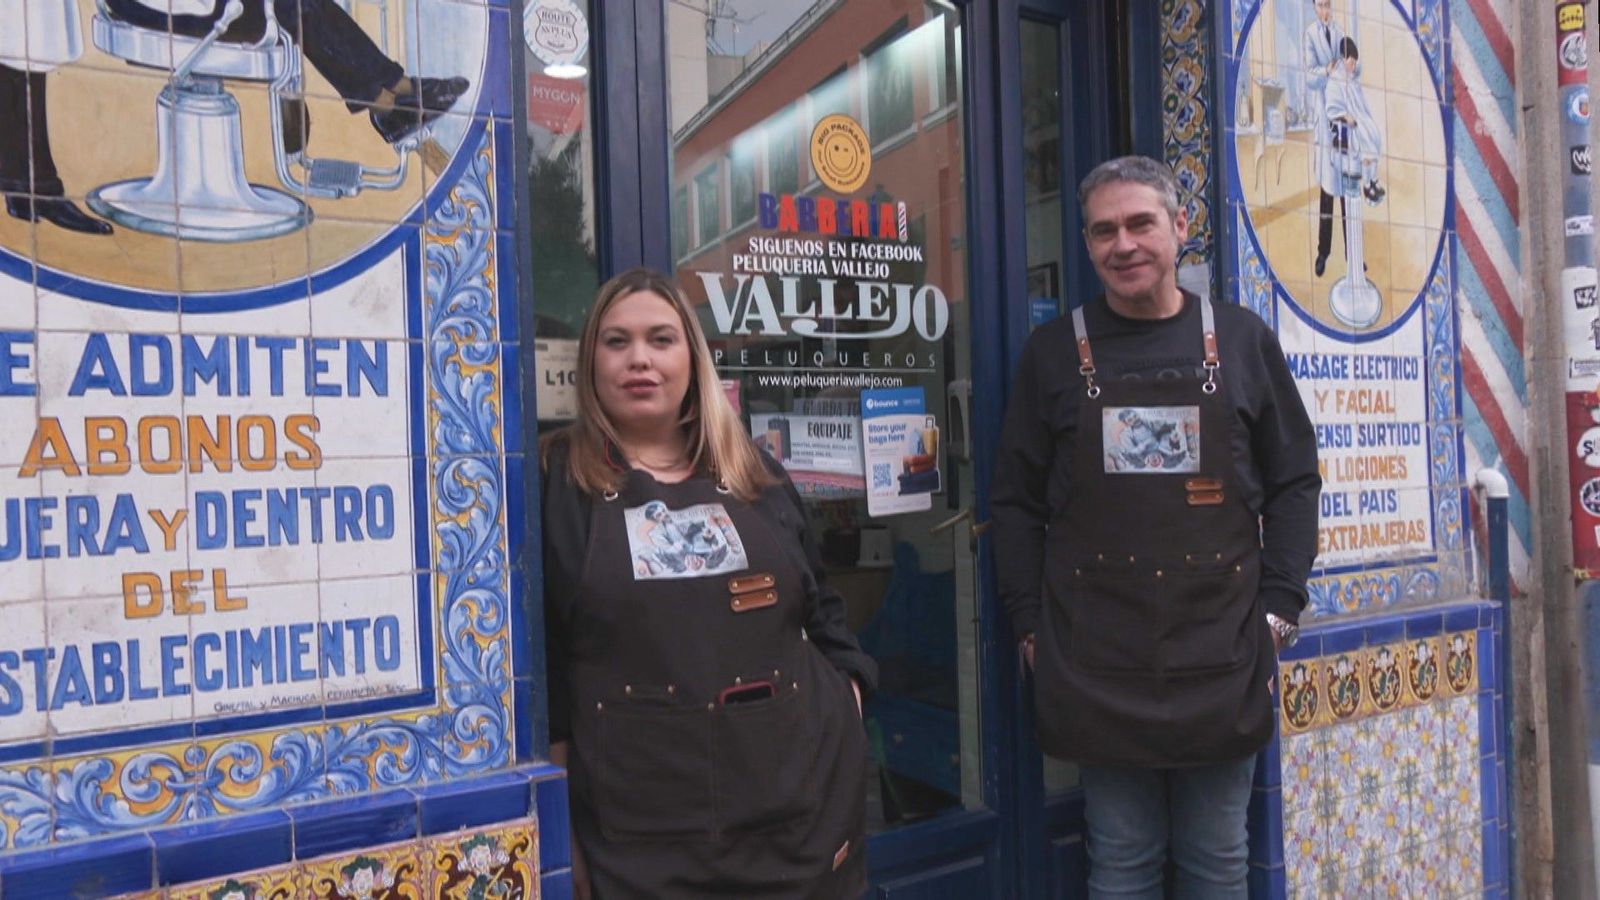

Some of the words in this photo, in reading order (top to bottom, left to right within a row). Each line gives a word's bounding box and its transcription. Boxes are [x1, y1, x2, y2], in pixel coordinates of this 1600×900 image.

[748, 236, 824, 258] SIGUENOS
[828, 241, 846, 258] EN
[851, 242, 923, 262] FACEBOOK
[733, 254, 827, 276] PELUQUERIA
[832, 261, 890, 279] VALLEJO
[695, 270, 949, 342] VALLEJO
[68, 331, 389, 397] ADMITEN
[715, 348, 936, 367] PELUQUEROS
[1286, 353, 1348, 380] MASAGE
[1353, 355, 1419, 380] ELECTRICO
[758, 373, 903, 390] www.peluqueriavallejo.com
[1314, 388, 1329, 413] Y
[1335, 388, 1395, 414] FACIAL
[807, 421, 853, 440] EQUIPAJE
[868, 423, 889, 433] Store
[890, 423, 906, 434] your
[868, 434, 888, 445] bags
[888, 432, 905, 443] here
[1358, 422, 1421, 447] SURTIDO
[17, 413, 323, 478] ABONOS
[1335, 455, 1407, 482] LOCIONES
[1321, 490, 1352, 517] DEL
[1359, 488, 1397, 515] PAIS
[148, 509, 189, 552] Y
[195, 484, 396, 550] DENTRO
[1318, 518, 1426, 554] EXTRANJERAS
[121, 568, 248, 620] DEL
